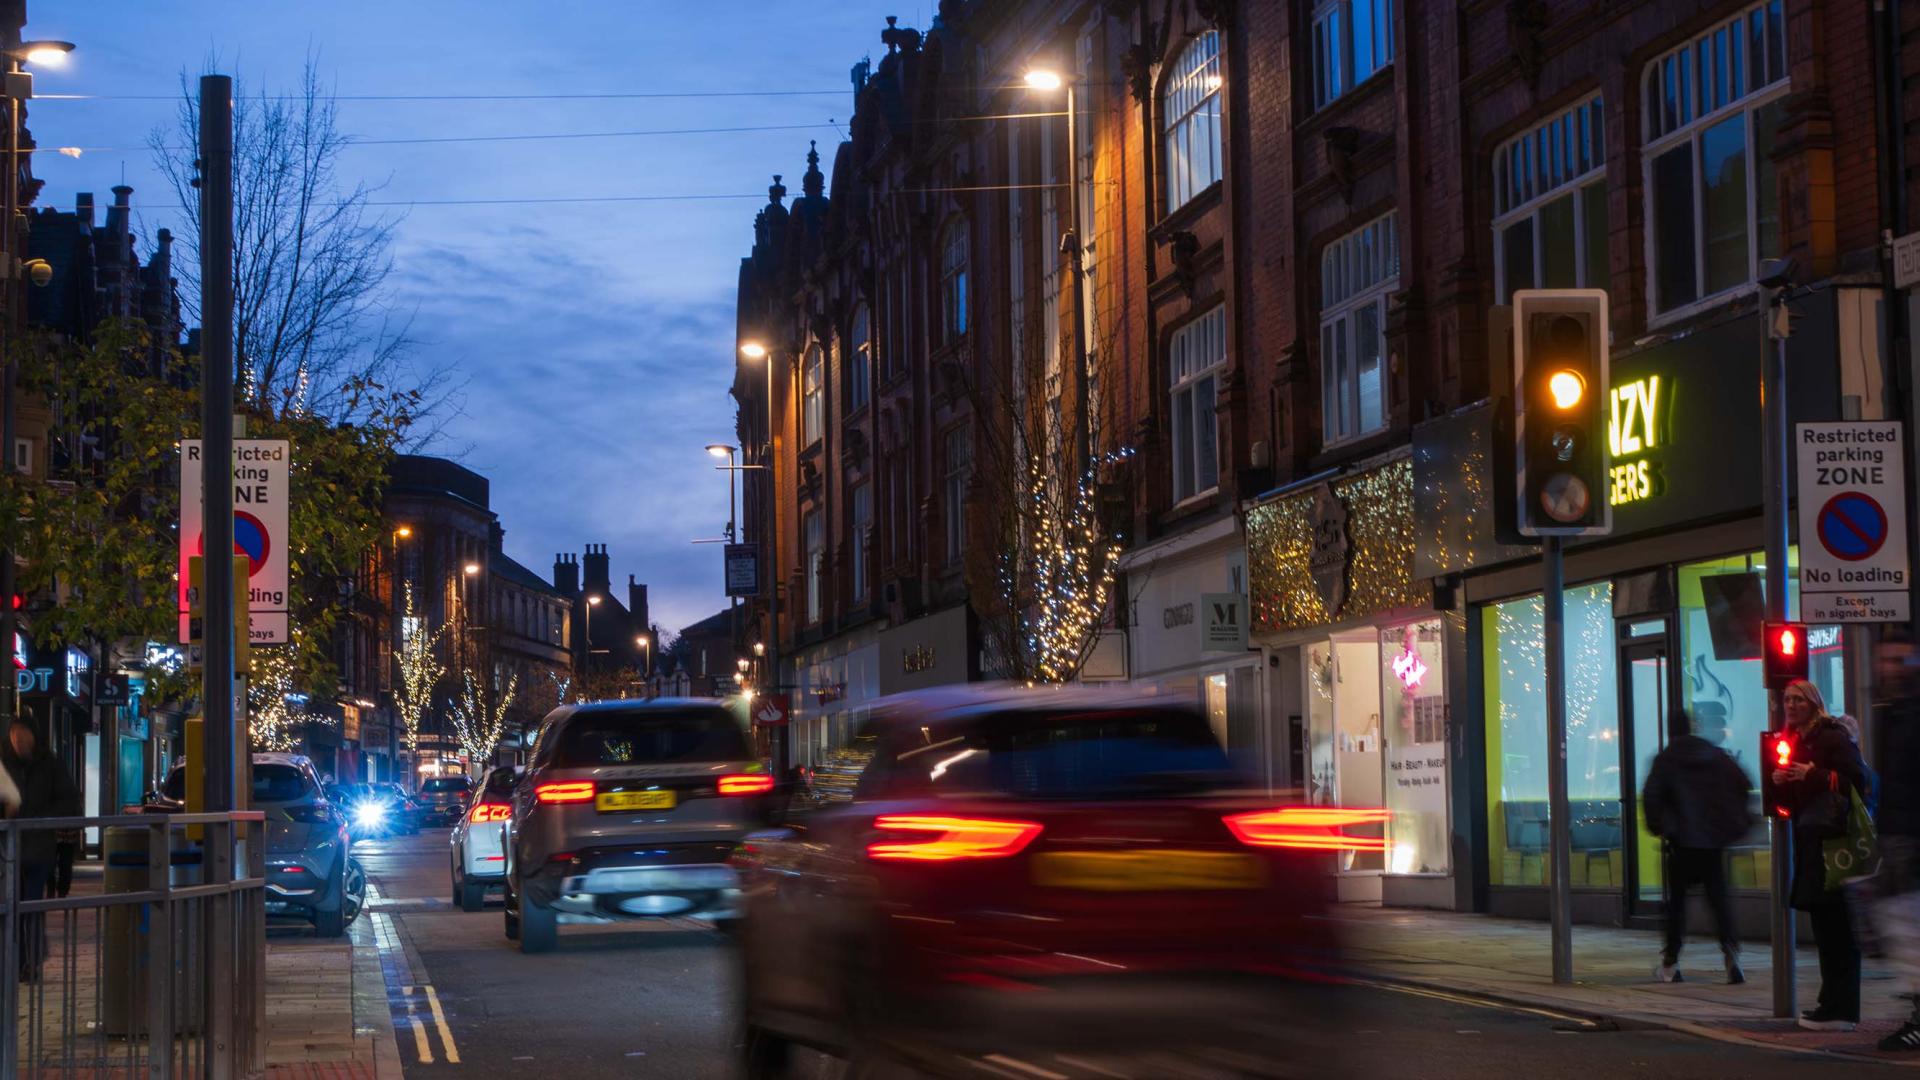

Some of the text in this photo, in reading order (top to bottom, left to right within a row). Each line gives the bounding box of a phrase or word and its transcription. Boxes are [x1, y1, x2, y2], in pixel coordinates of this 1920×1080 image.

[1803, 428, 1896, 443] Restricted
[188, 446, 283, 461] Ricted
[1816, 449, 1884, 464] parking
[233, 465, 269, 482] king
[1816, 467, 1884, 485] ZONE
[235, 485, 268, 503] NE
[1805, 568, 1904, 584] No loading
[1836, 596, 1875, 607] Except
[1815, 608, 1897, 619] in signed bays
